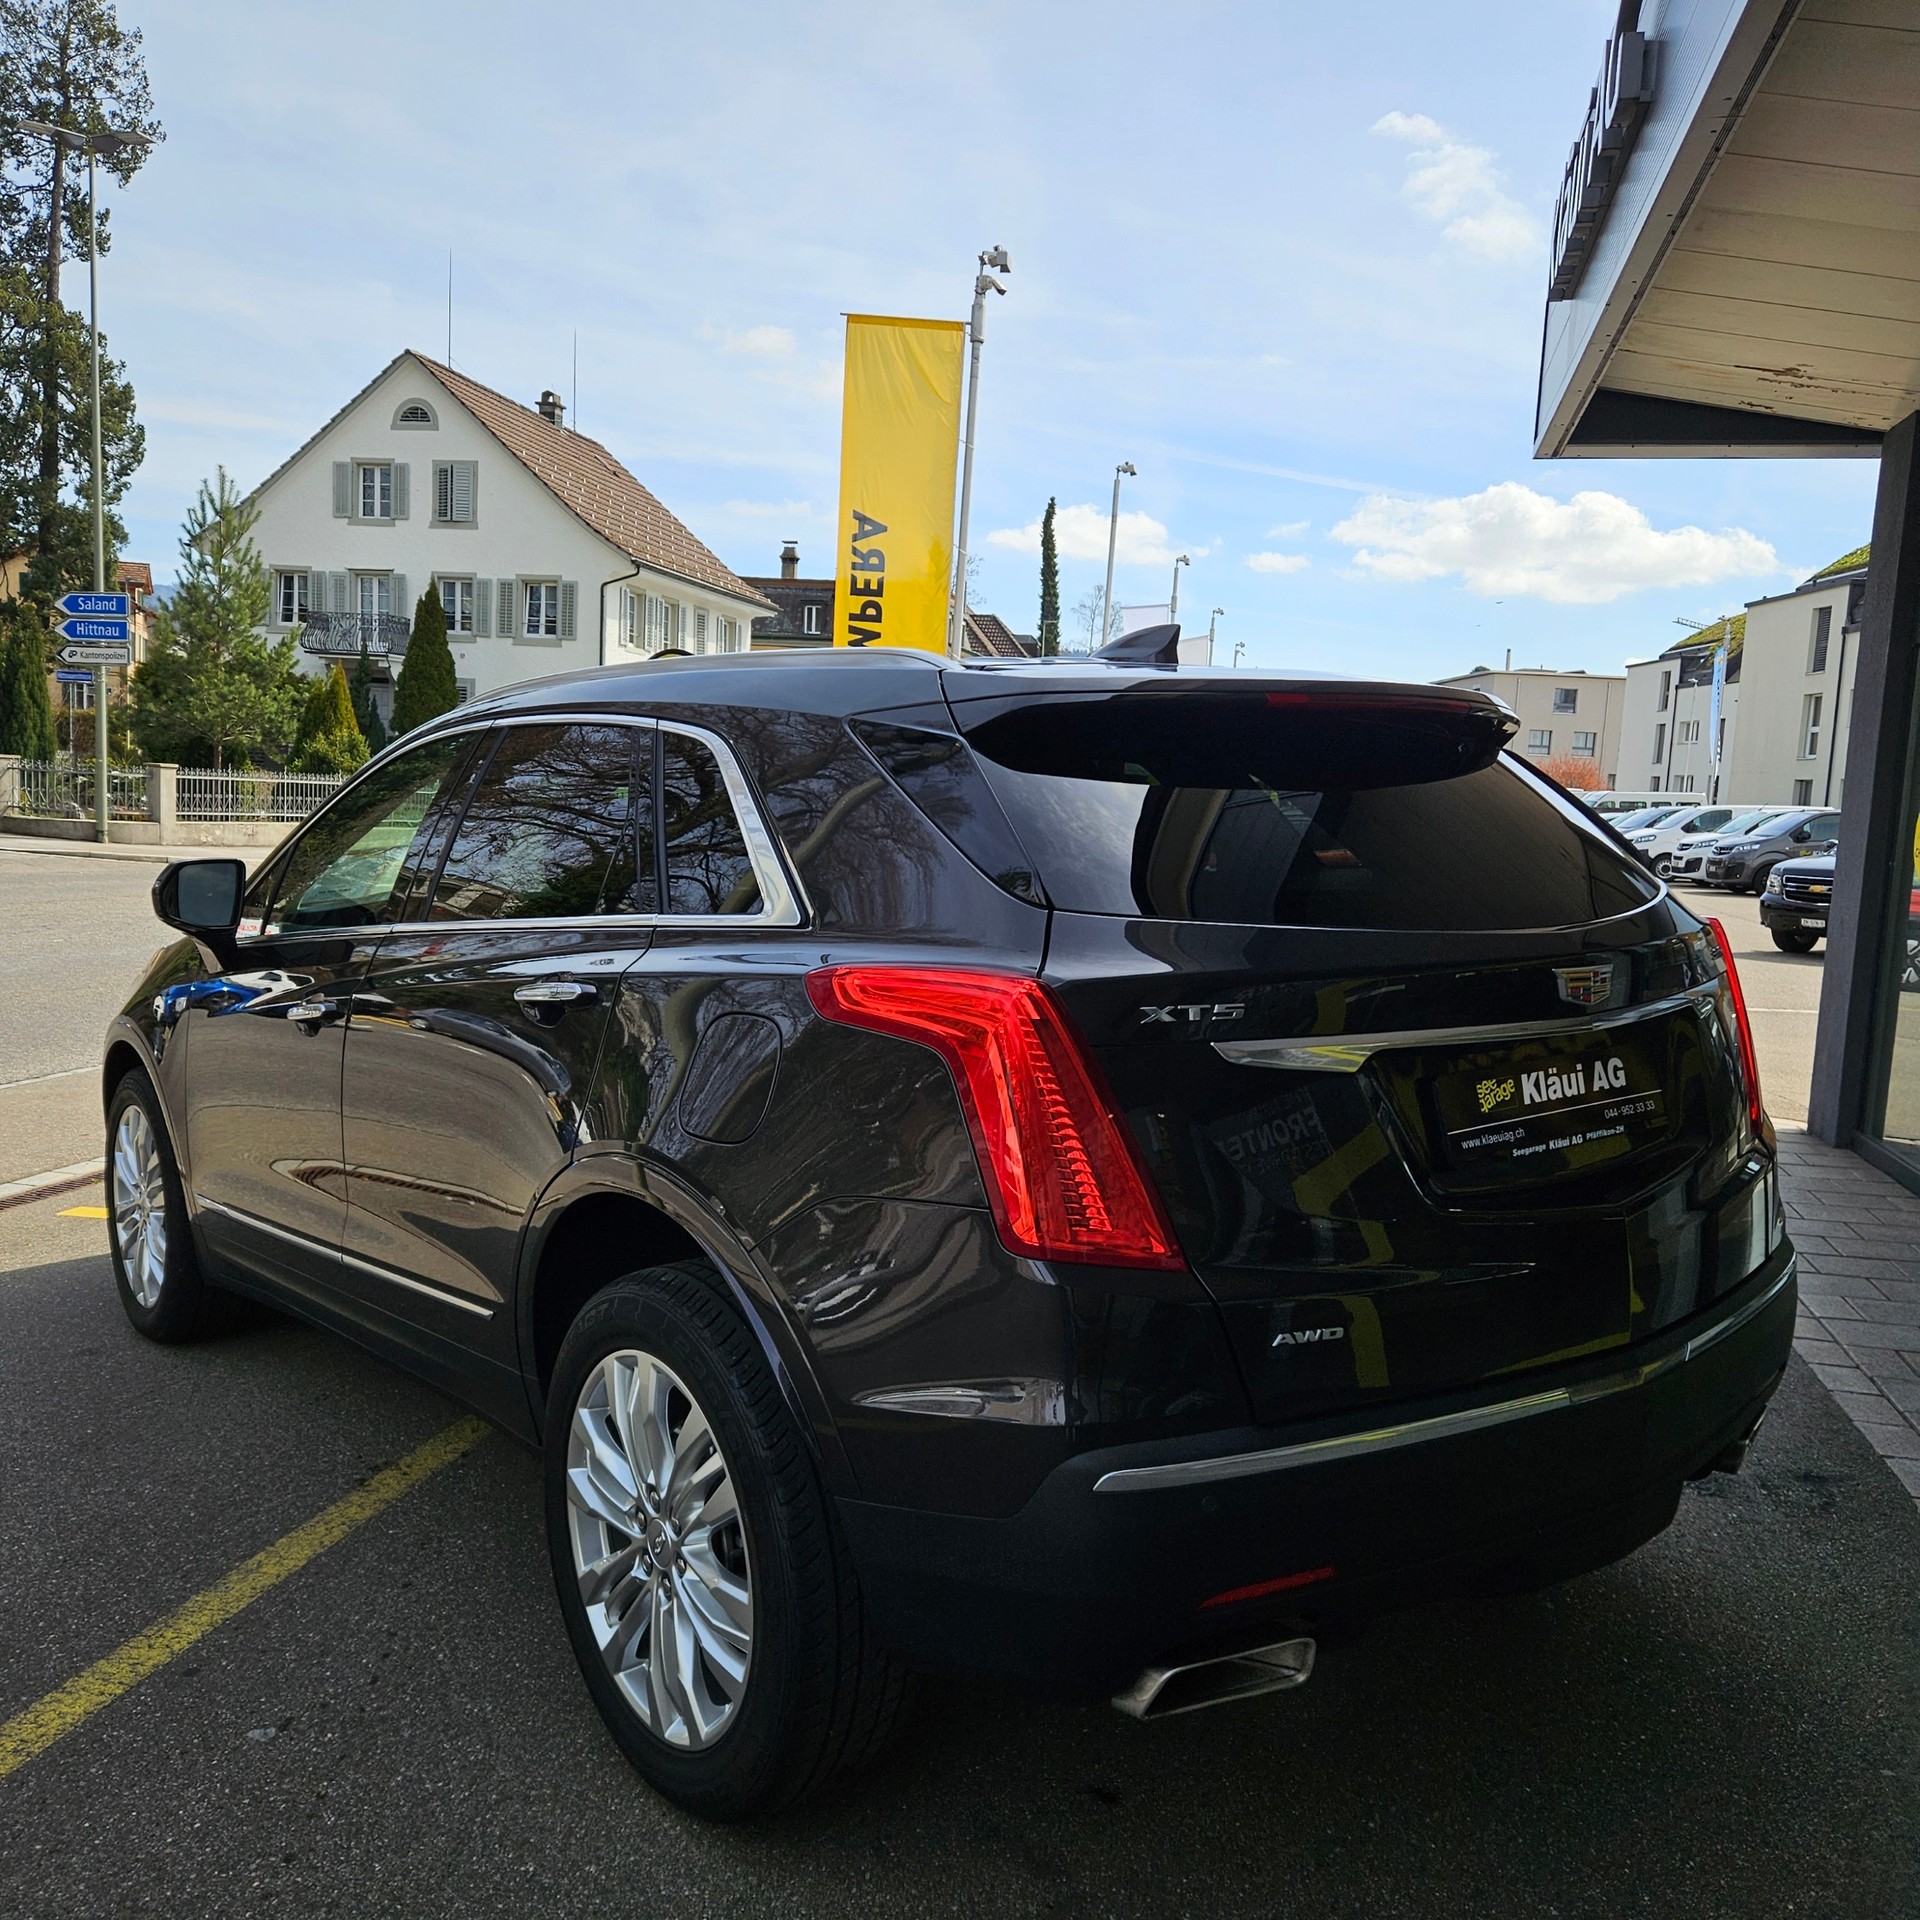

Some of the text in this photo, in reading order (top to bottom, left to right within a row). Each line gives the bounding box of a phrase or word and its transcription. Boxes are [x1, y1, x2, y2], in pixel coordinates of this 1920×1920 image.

[78, 597, 116, 611] Saland
[76, 622, 120, 636] Hittnau
[80, 650, 126, 660] Kantonspolizei
[1140, 1003, 1245, 1024] XT5
[1521, 1057, 1627, 1105] Kläui AG
[1635, 1102, 1645, 1113] 33
[1645, 1099, 1655, 1111] 33
[1460, 1127, 1525, 1150] www.klaeuiag.ch
[1512, 1143, 1547, 1157] Seegarage
[1548, 1136, 1570, 1150] Kläui
[1571, 1133, 1583, 1145] AG
[1271, 1326, 1345, 1347] AWD
